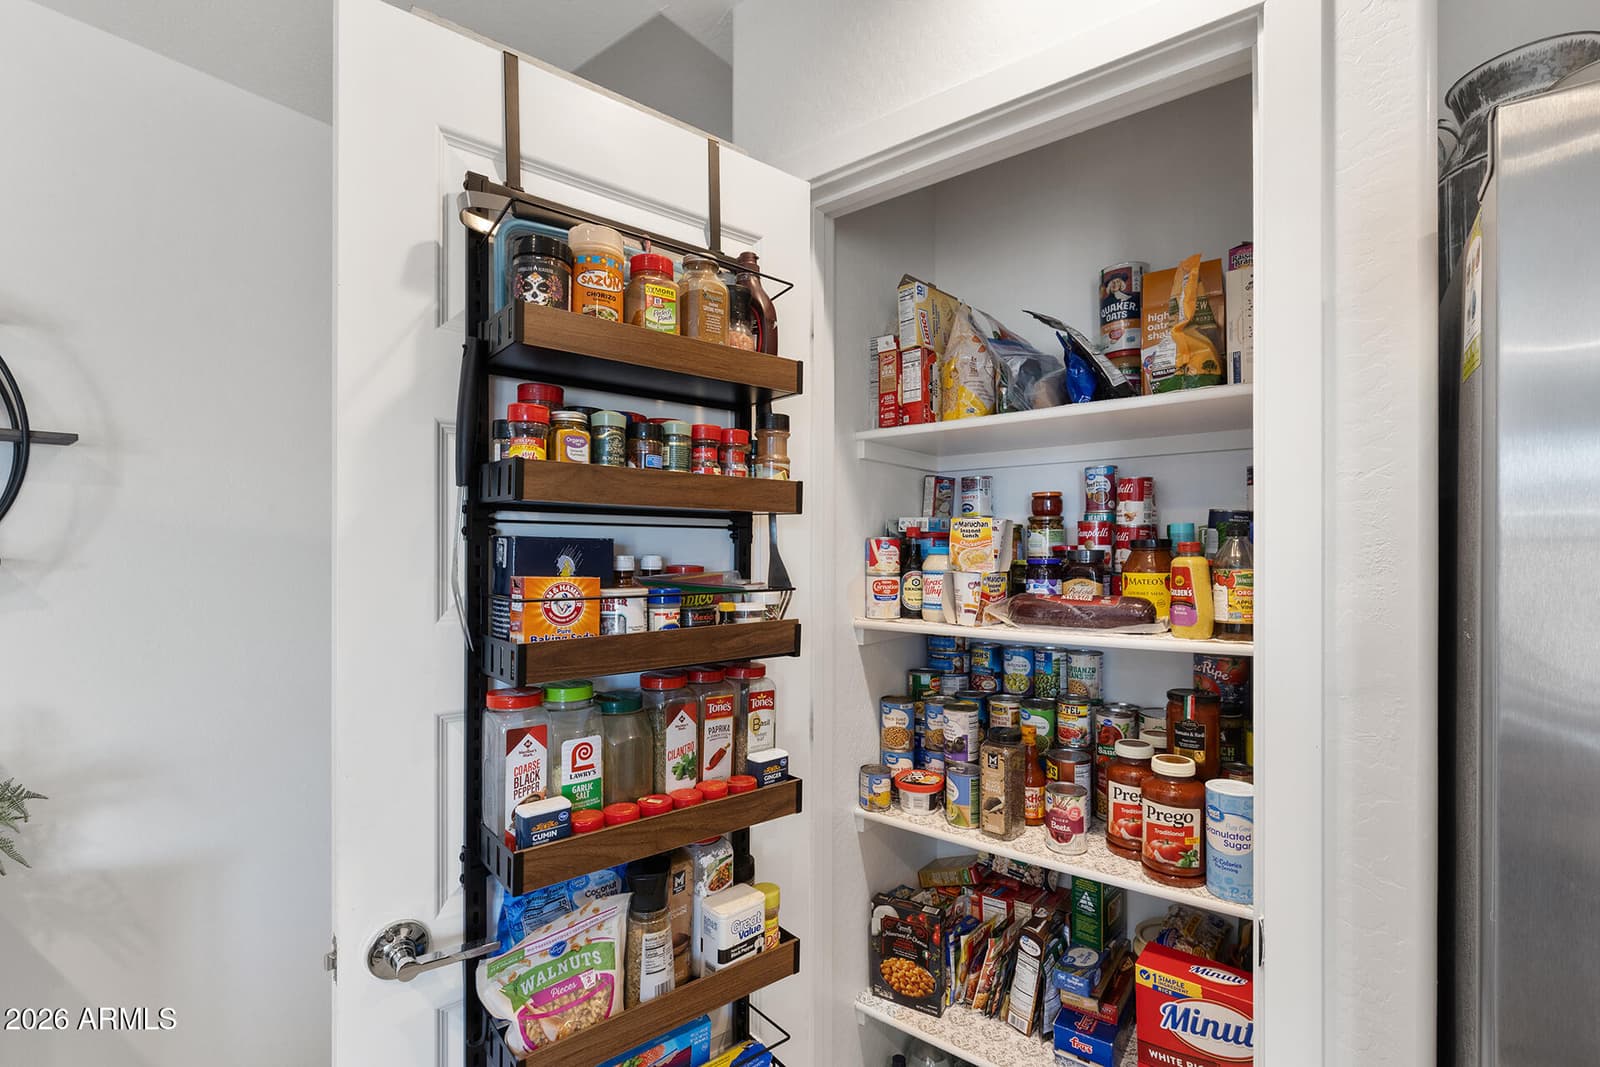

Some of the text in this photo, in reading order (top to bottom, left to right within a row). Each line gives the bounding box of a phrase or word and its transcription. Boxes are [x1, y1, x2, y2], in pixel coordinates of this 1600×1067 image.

[586, 291, 617, 302] CHORIZO
[655, 287, 675, 297] MORE
[1100, 301, 1137, 318] QUAKER
[1106, 310, 1128, 323] OATS
[1148, 311, 1169, 323] high
[919, 311, 932, 347] Lance
[958, 520, 989, 528] Maruchan
[873, 581, 898, 592] Carnation
[1128, 577, 1165, 586] MATEO'S
[1171, 587, 1193, 597] GULDEN'S
[1202, 661, 1230, 681] Ripe
[707, 702, 731, 714] Tone's
[750, 697, 773, 709] Tone's
[708, 724, 731, 736] PAPRIKA
[667, 741, 695, 762] CILANTRO
[513, 759, 541, 775] COARSE
[513, 769, 541, 789] BLACK
[569, 770, 597, 780] LAWRY'S
[763, 772, 782, 782] GINGER
[513, 781, 540, 800] PEPPER
[571, 782, 594, 793] GARLIC
[576, 791, 591, 801] SALT
[1146, 805, 1194, 828] Prego
[1051, 821, 1072, 832] Beets
[1154, 828, 1186, 837] Traditional
[532, 829, 558, 842] CUMIN
[1223, 839, 1251, 852] Sugar
[585, 881, 617, 897] Coconut
[731, 910, 762, 935] Great
[738, 924, 762, 940] Value
[520, 949, 602, 996] WALNUTS
[1189, 965, 1248, 985] Minute
[1152, 974, 1185, 988] 1 SIMPLE
[1158, 980, 1189, 995] INGREDIENT
[550, 981, 578, 997] Pieces
[1157, 986, 1173, 995] RICE
[1148, 1049, 1184, 1067] WHITE
